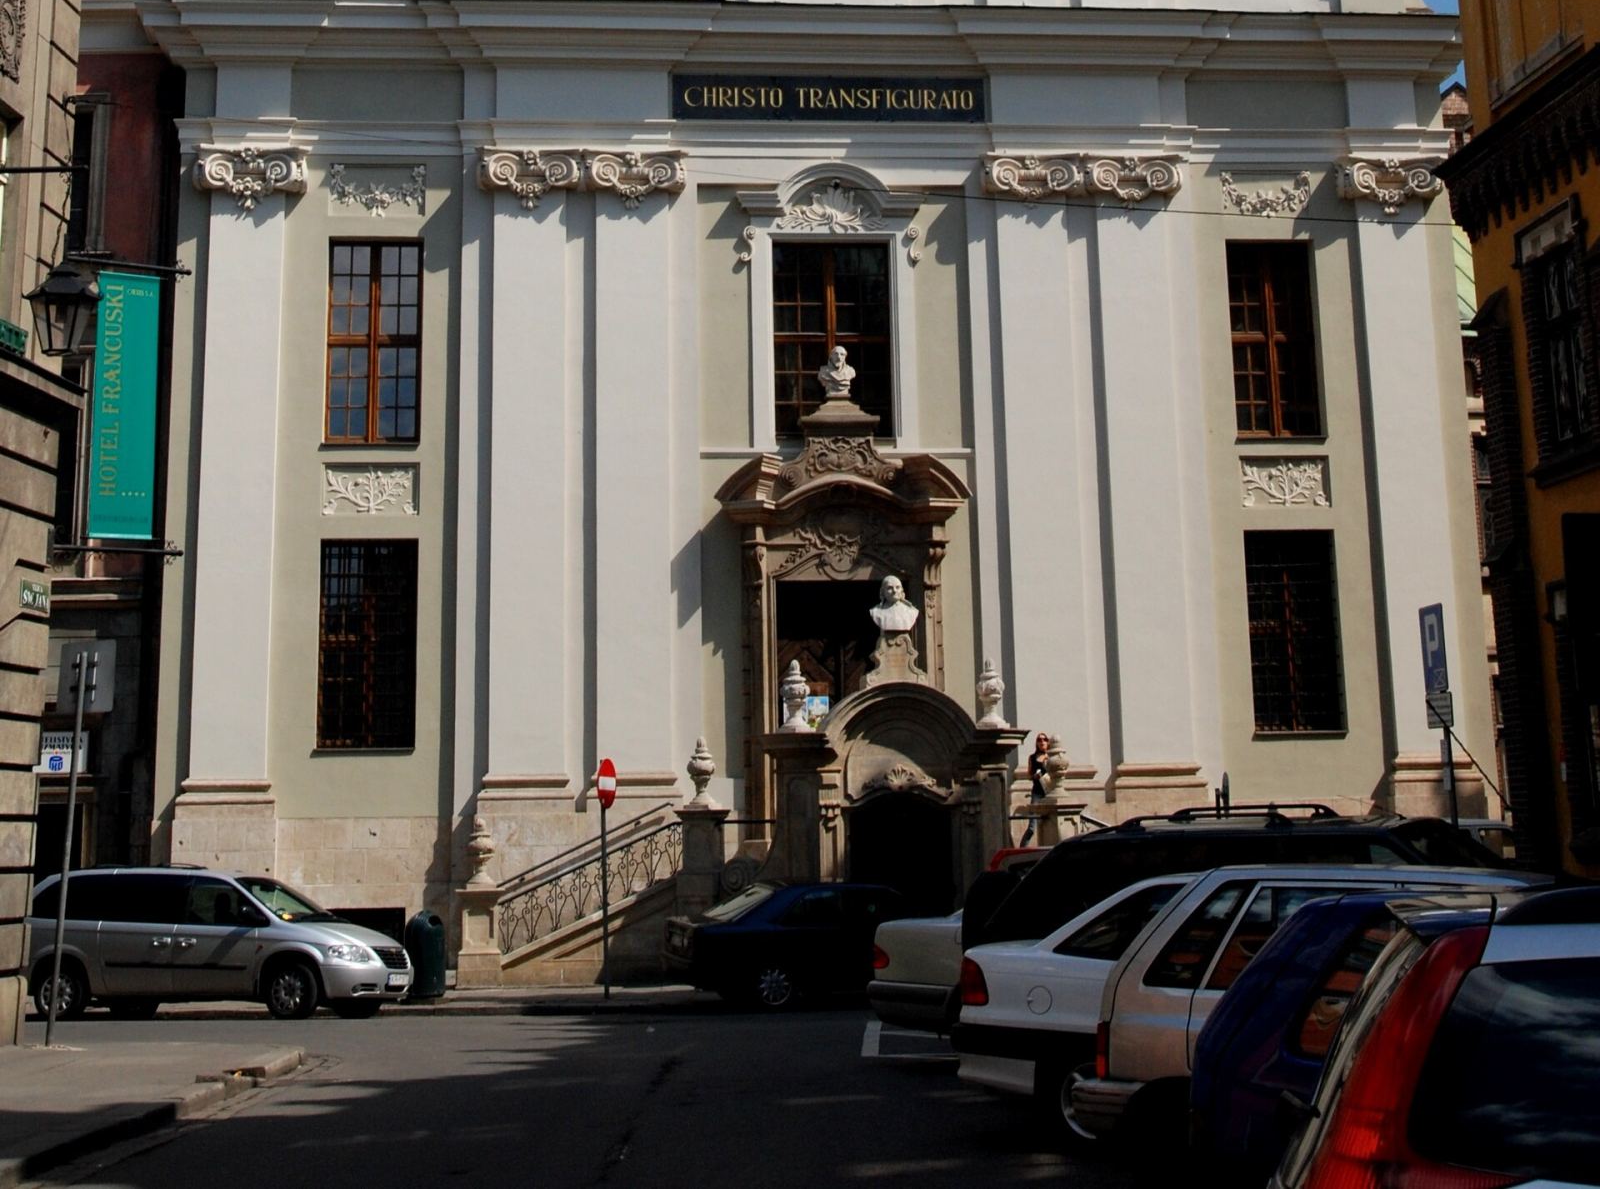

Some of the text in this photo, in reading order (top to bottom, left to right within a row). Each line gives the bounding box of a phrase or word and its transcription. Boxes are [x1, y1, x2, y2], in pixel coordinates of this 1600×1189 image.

[684, 86, 974, 110] CHRISTO TRANSFIGURATO
[99, 284, 124, 497] HOTEL FRANCUSKI
[1424, 613, 1439, 668] P
